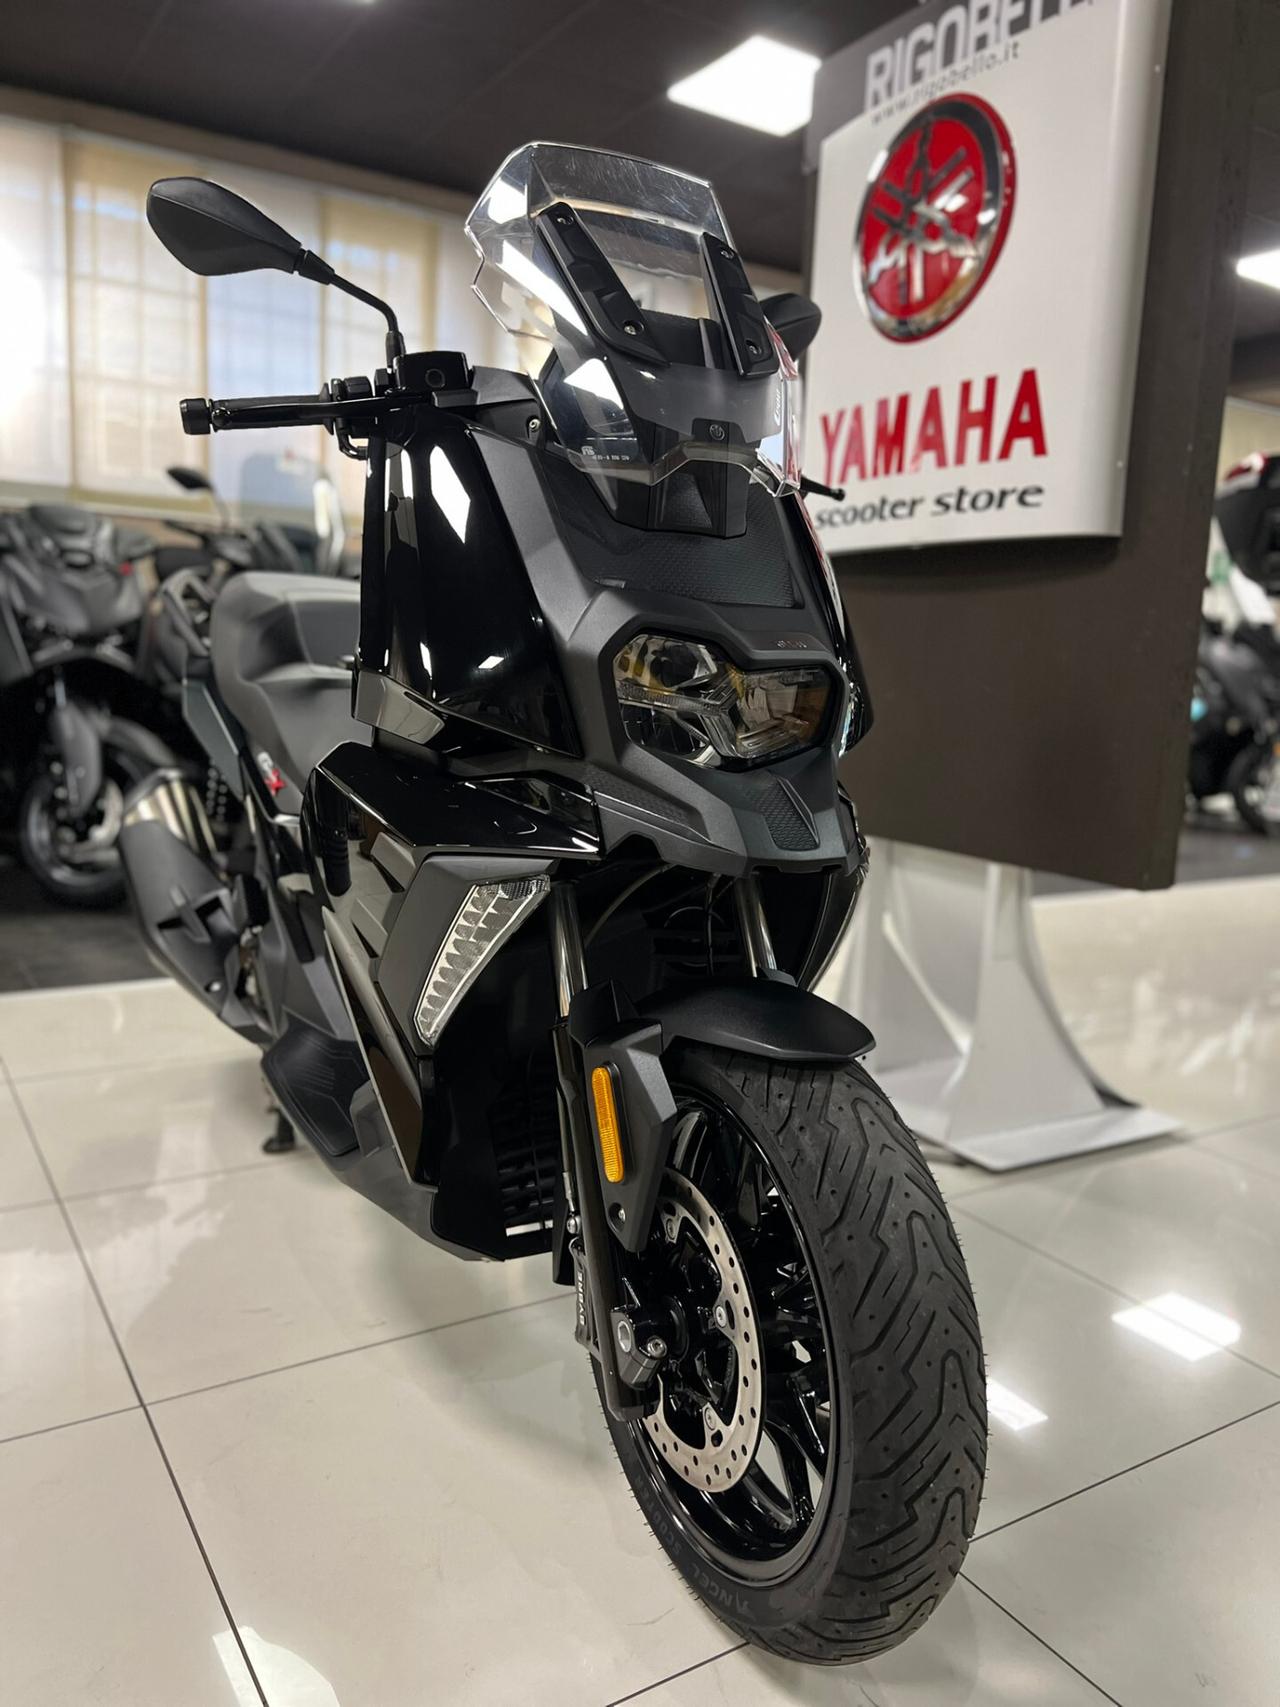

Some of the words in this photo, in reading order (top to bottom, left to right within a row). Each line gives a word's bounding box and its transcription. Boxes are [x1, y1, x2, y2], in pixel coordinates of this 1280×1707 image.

[820, 368, 1048, 489] YAMAHA
[815, 495, 924, 530] scooter
[931, 484, 1044, 517] store
[687, 1563, 757, 1622] ANGEL
